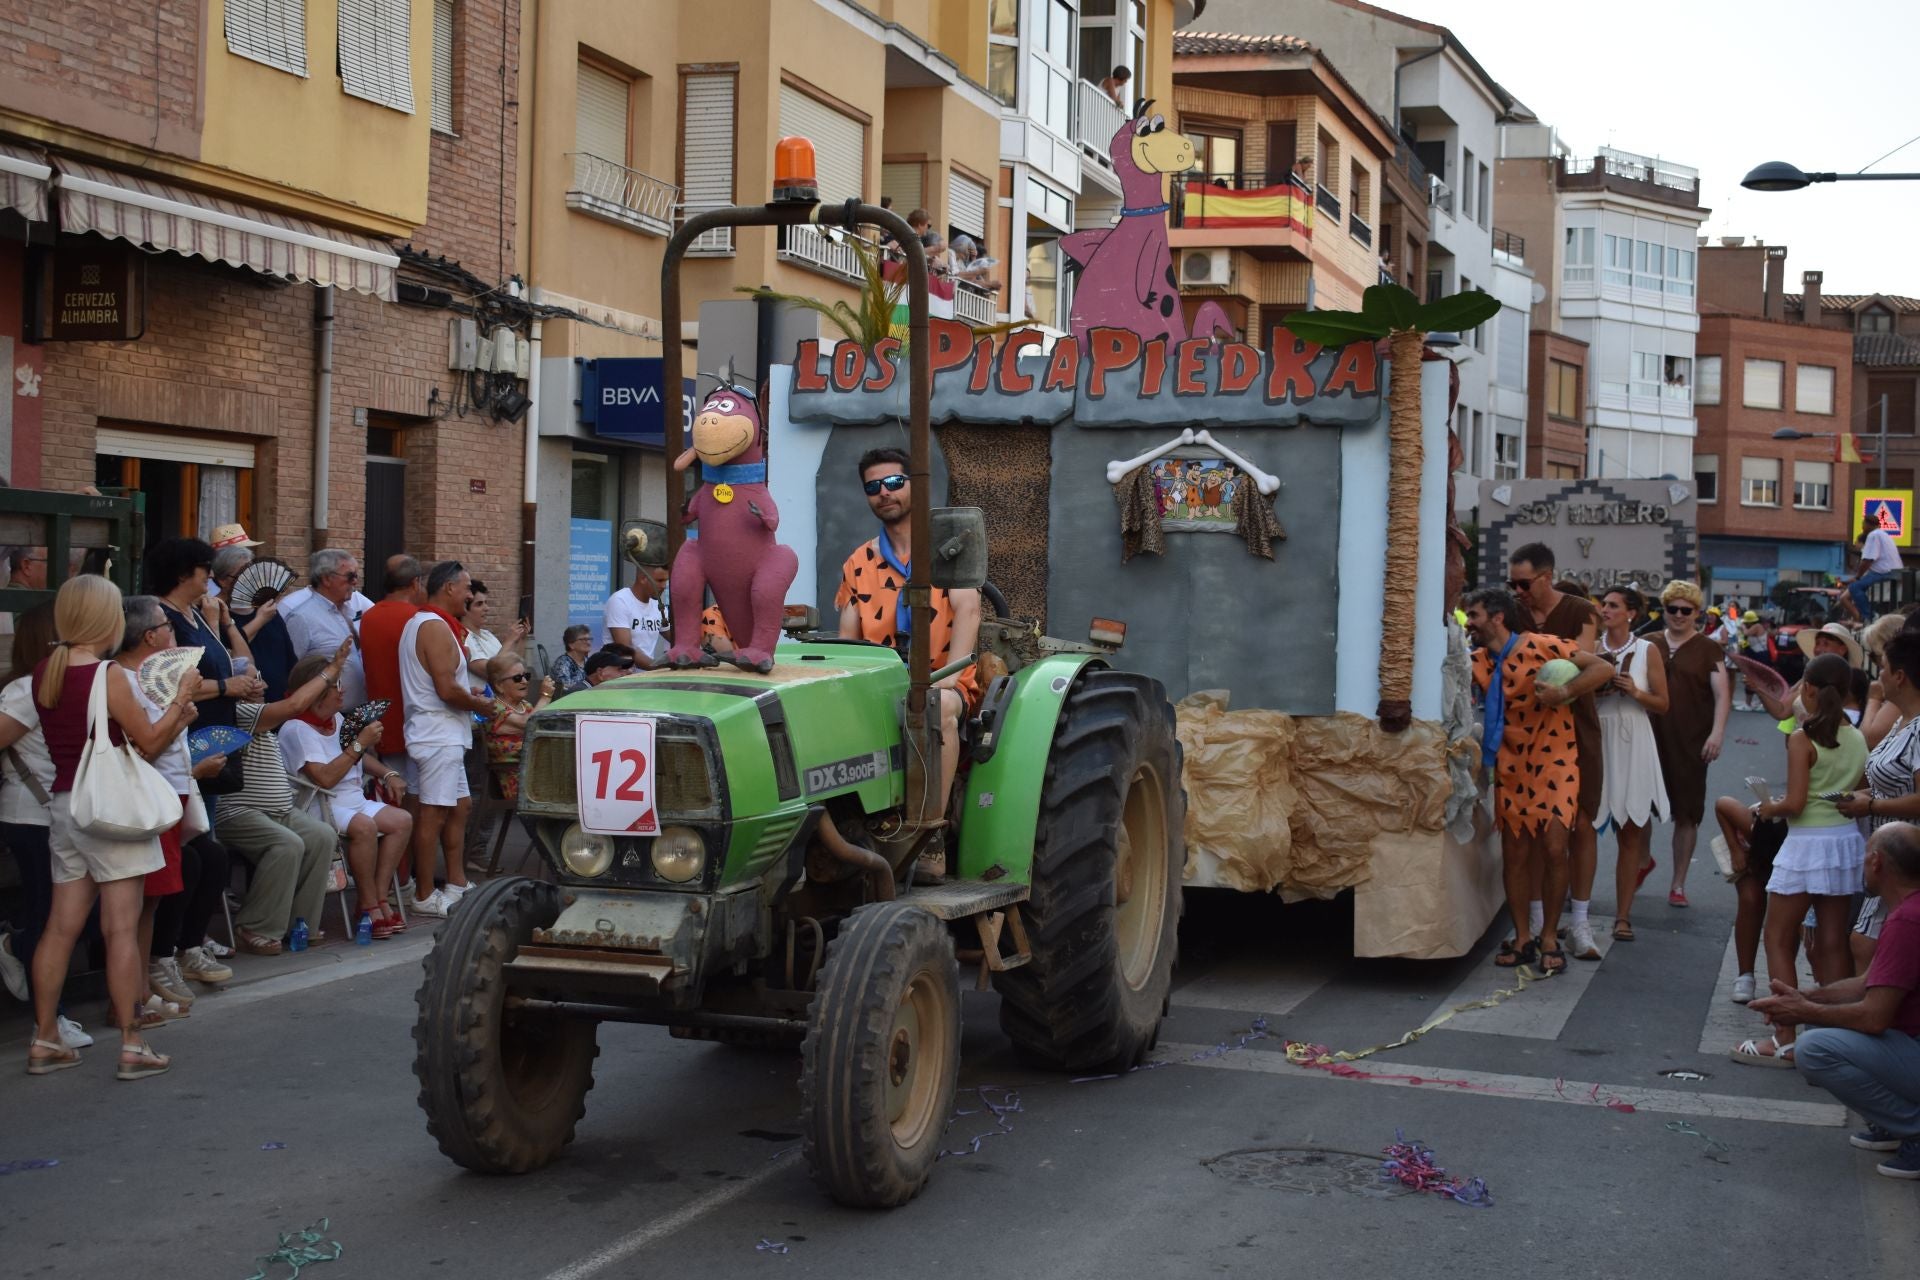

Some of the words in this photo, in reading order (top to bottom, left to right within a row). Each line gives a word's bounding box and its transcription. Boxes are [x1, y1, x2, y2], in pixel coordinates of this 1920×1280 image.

[64, 292, 116, 307] CERVEZAS
[61, 309, 119, 324] ALHAMBRA
[793, 336, 902, 394] LOS
[929, 317, 1380, 404] PICAPIEDRA
[602, 385, 660, 405] BBVA
[1516, 503, 1561, 525] SOY
[1567, 503, 1669, 526] MINERO
[1576, 536, 1595, 558] Y
[631, 617, 661, 631] PARIS
[591, 748, 647, 802] 12
